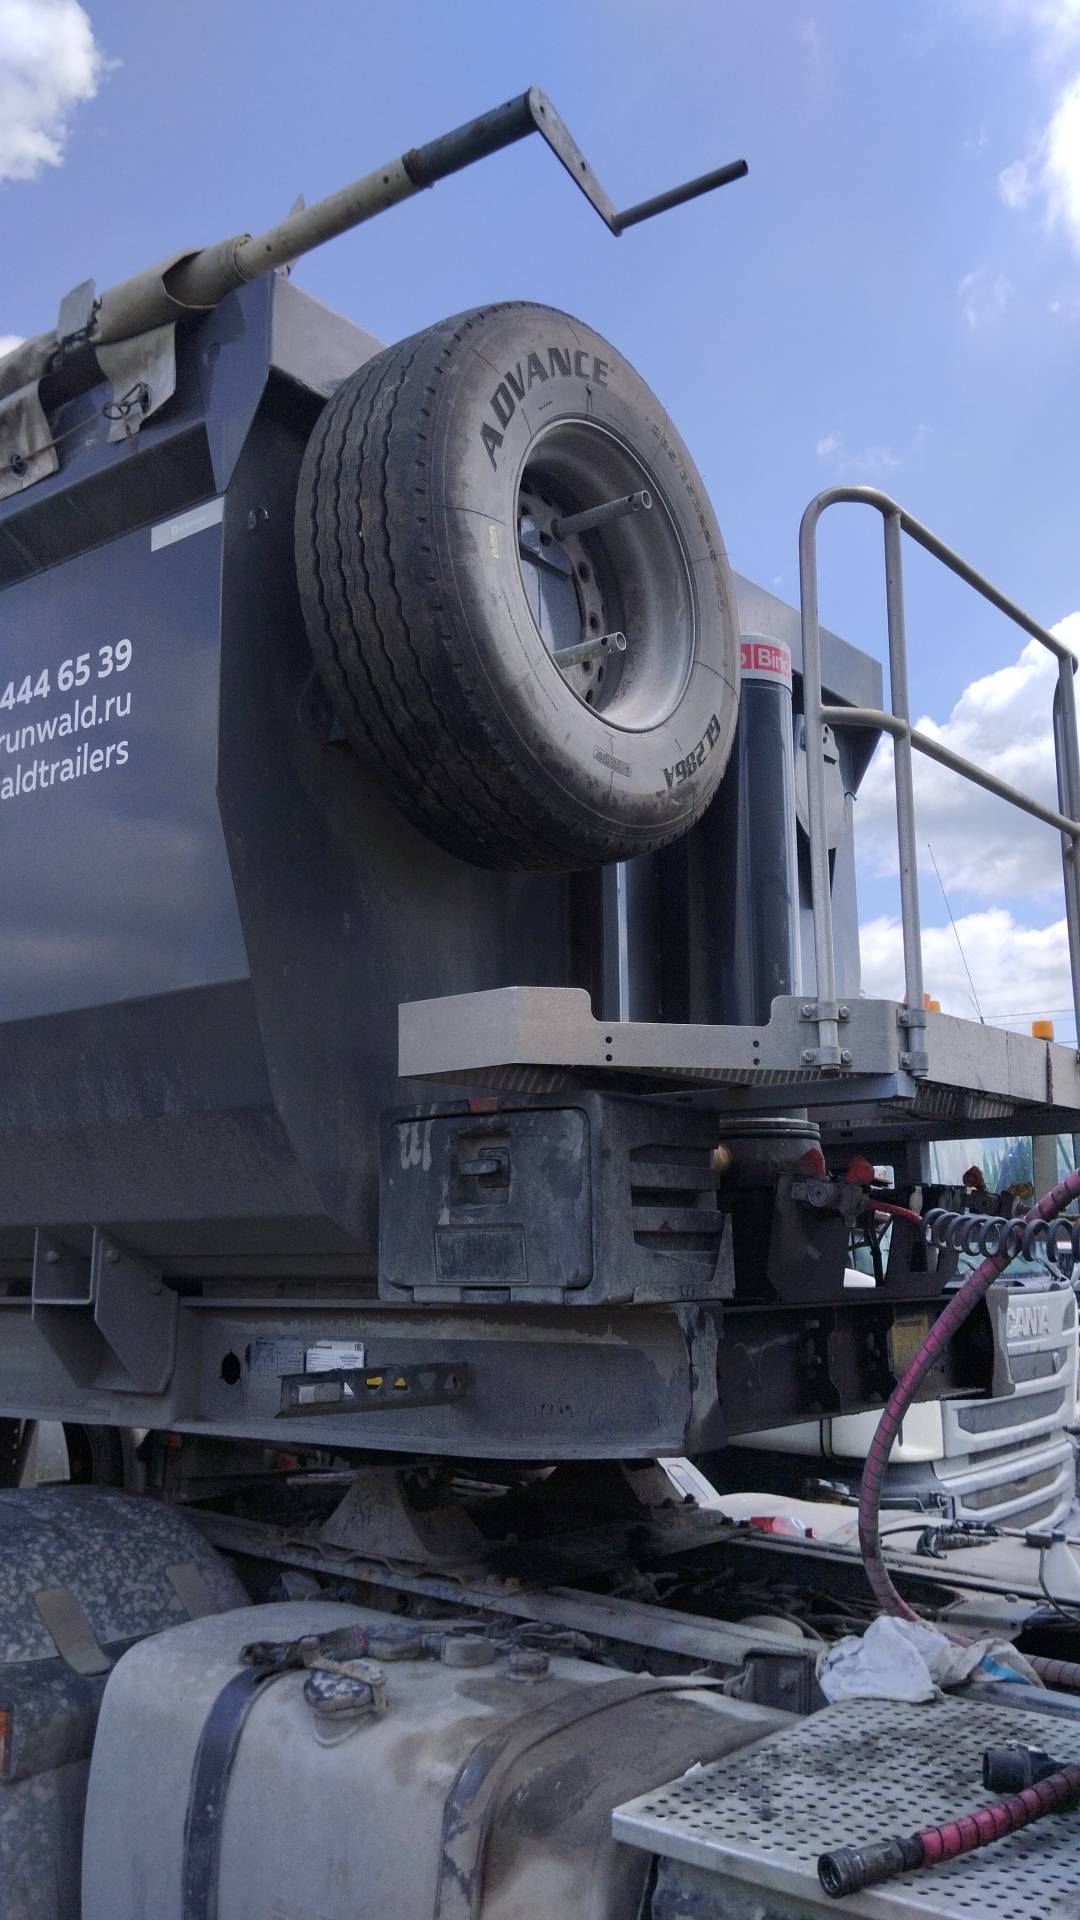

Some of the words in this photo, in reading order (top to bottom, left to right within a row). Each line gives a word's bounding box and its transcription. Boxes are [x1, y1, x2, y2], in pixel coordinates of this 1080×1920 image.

[480, 347, 609, 472] ADVANCE
[0, 669, 50, 710] 444
[57, 653, 91, 691] 65
[97, 638, 133, 678] 39
